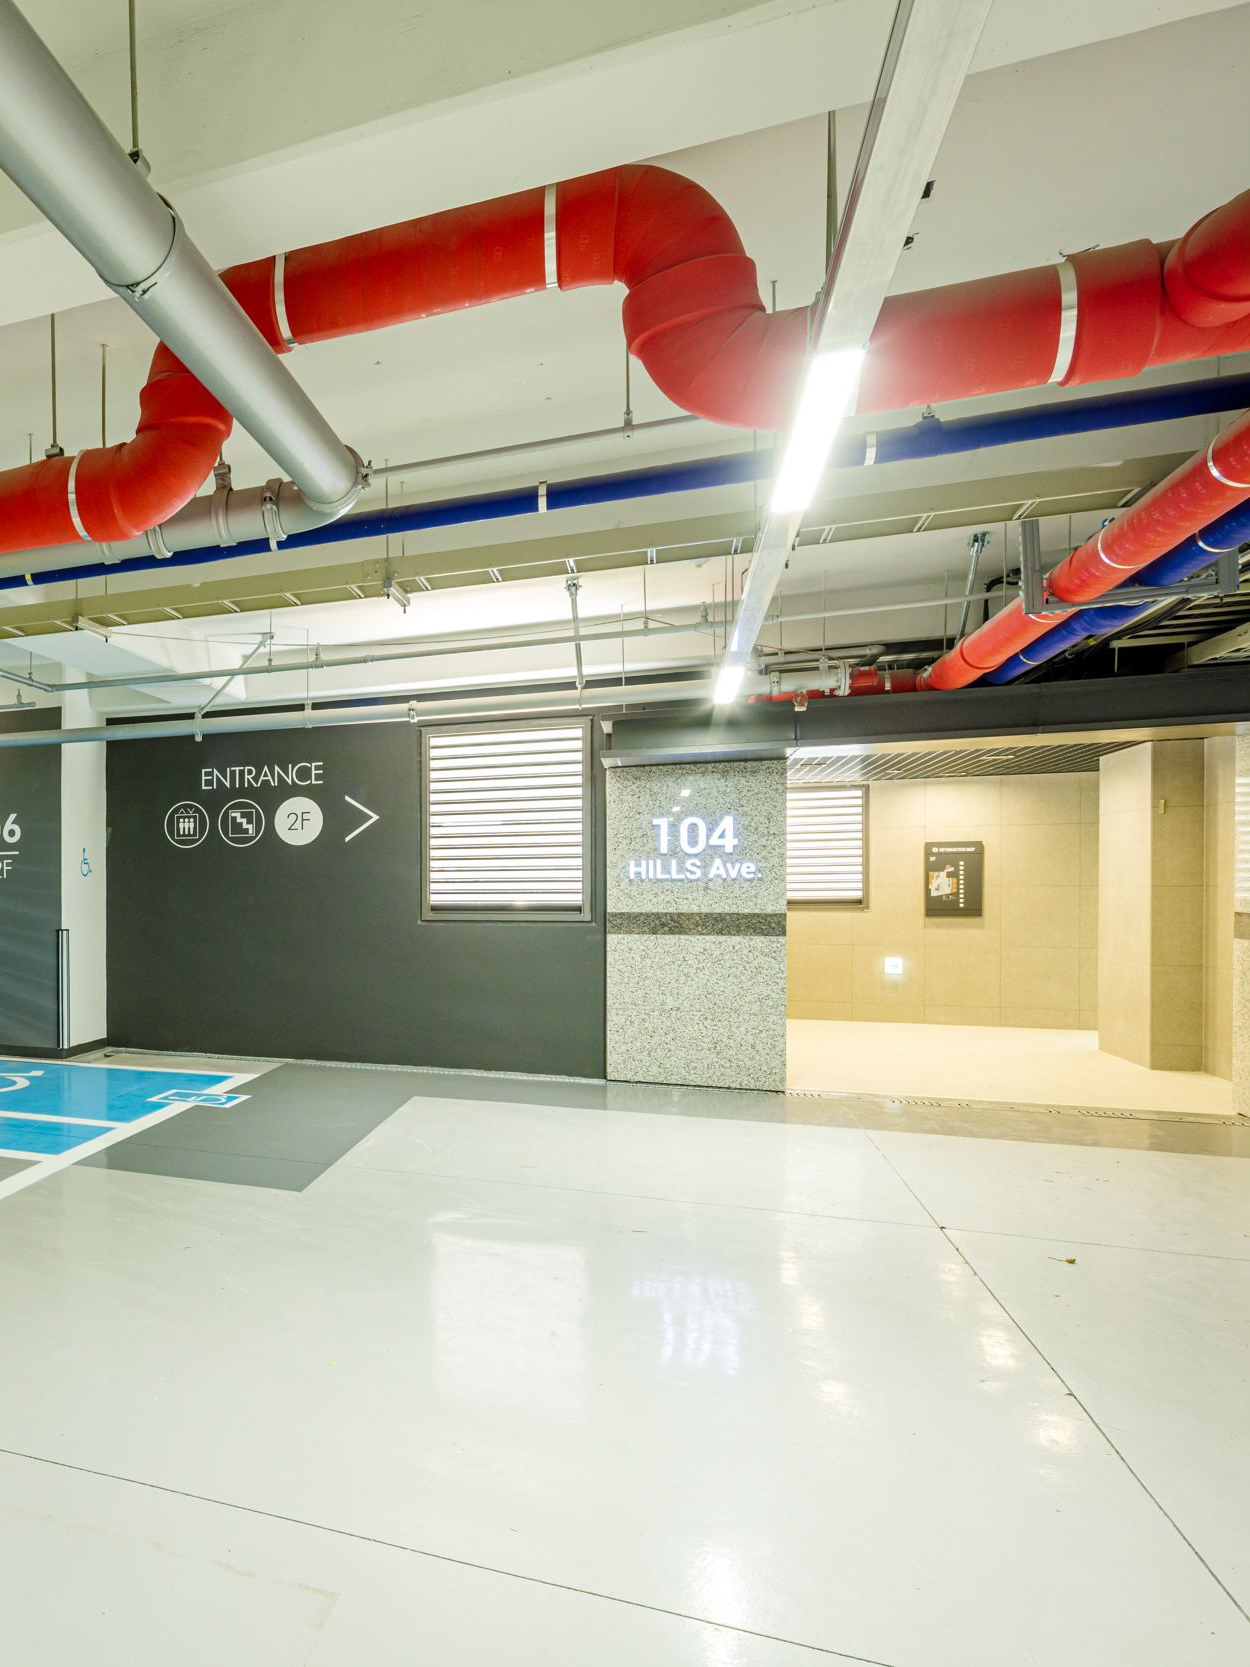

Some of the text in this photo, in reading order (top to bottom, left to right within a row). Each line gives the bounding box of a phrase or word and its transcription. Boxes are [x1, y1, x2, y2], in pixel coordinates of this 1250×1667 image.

[201, 762, 324, 790] ENTRANCE
[286, 811, 311, 831] 2F
[651, 815, 739, 855] 104
[628, 858, 763, 880] HILLS Ave.
